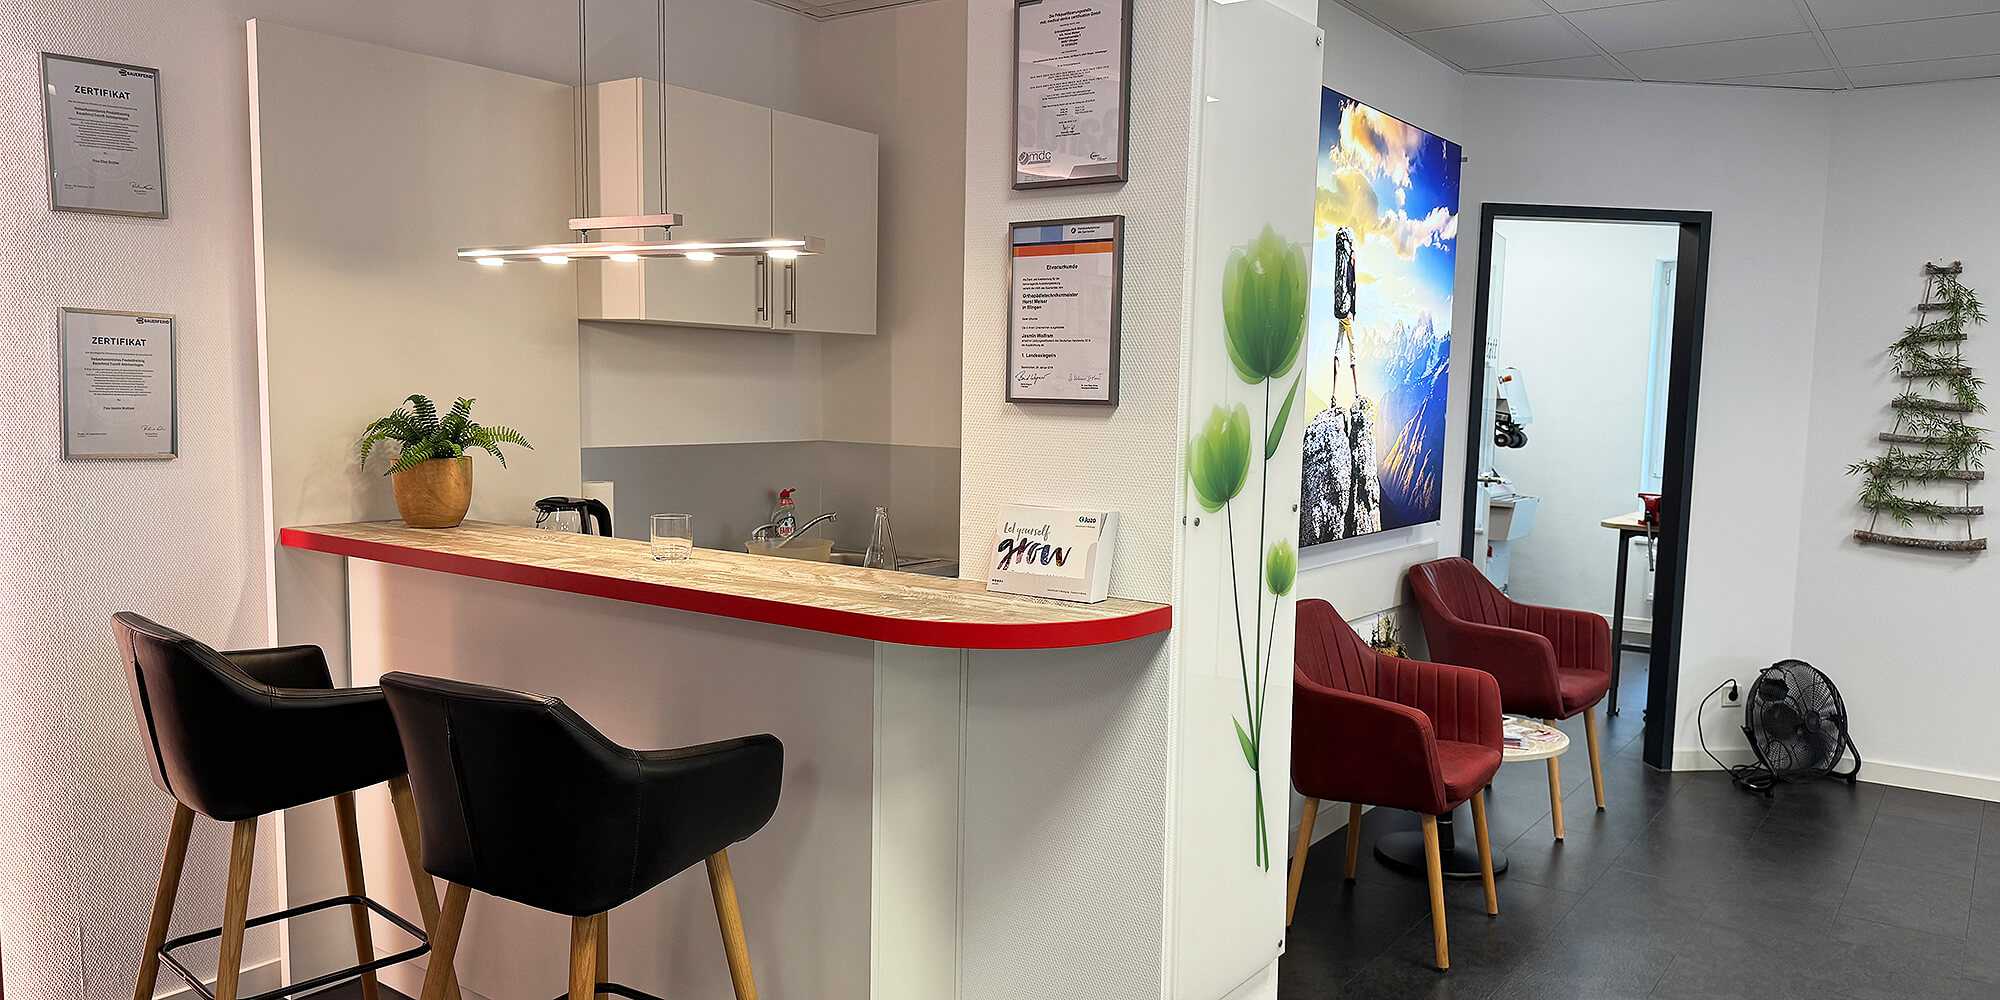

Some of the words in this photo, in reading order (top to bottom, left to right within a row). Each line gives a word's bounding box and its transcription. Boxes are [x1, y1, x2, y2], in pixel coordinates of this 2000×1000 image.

[74, 85, 130, 100] ZERTIFIKAT
[1029, 151, 1052, 161] mdc
[92, 336, 146, 346] ZERTIFIKAT
[1004, 522, 1016, 534] Let
[1016, 524, 1052, 542] yourself
[997, 538, 1072, 570] grow
